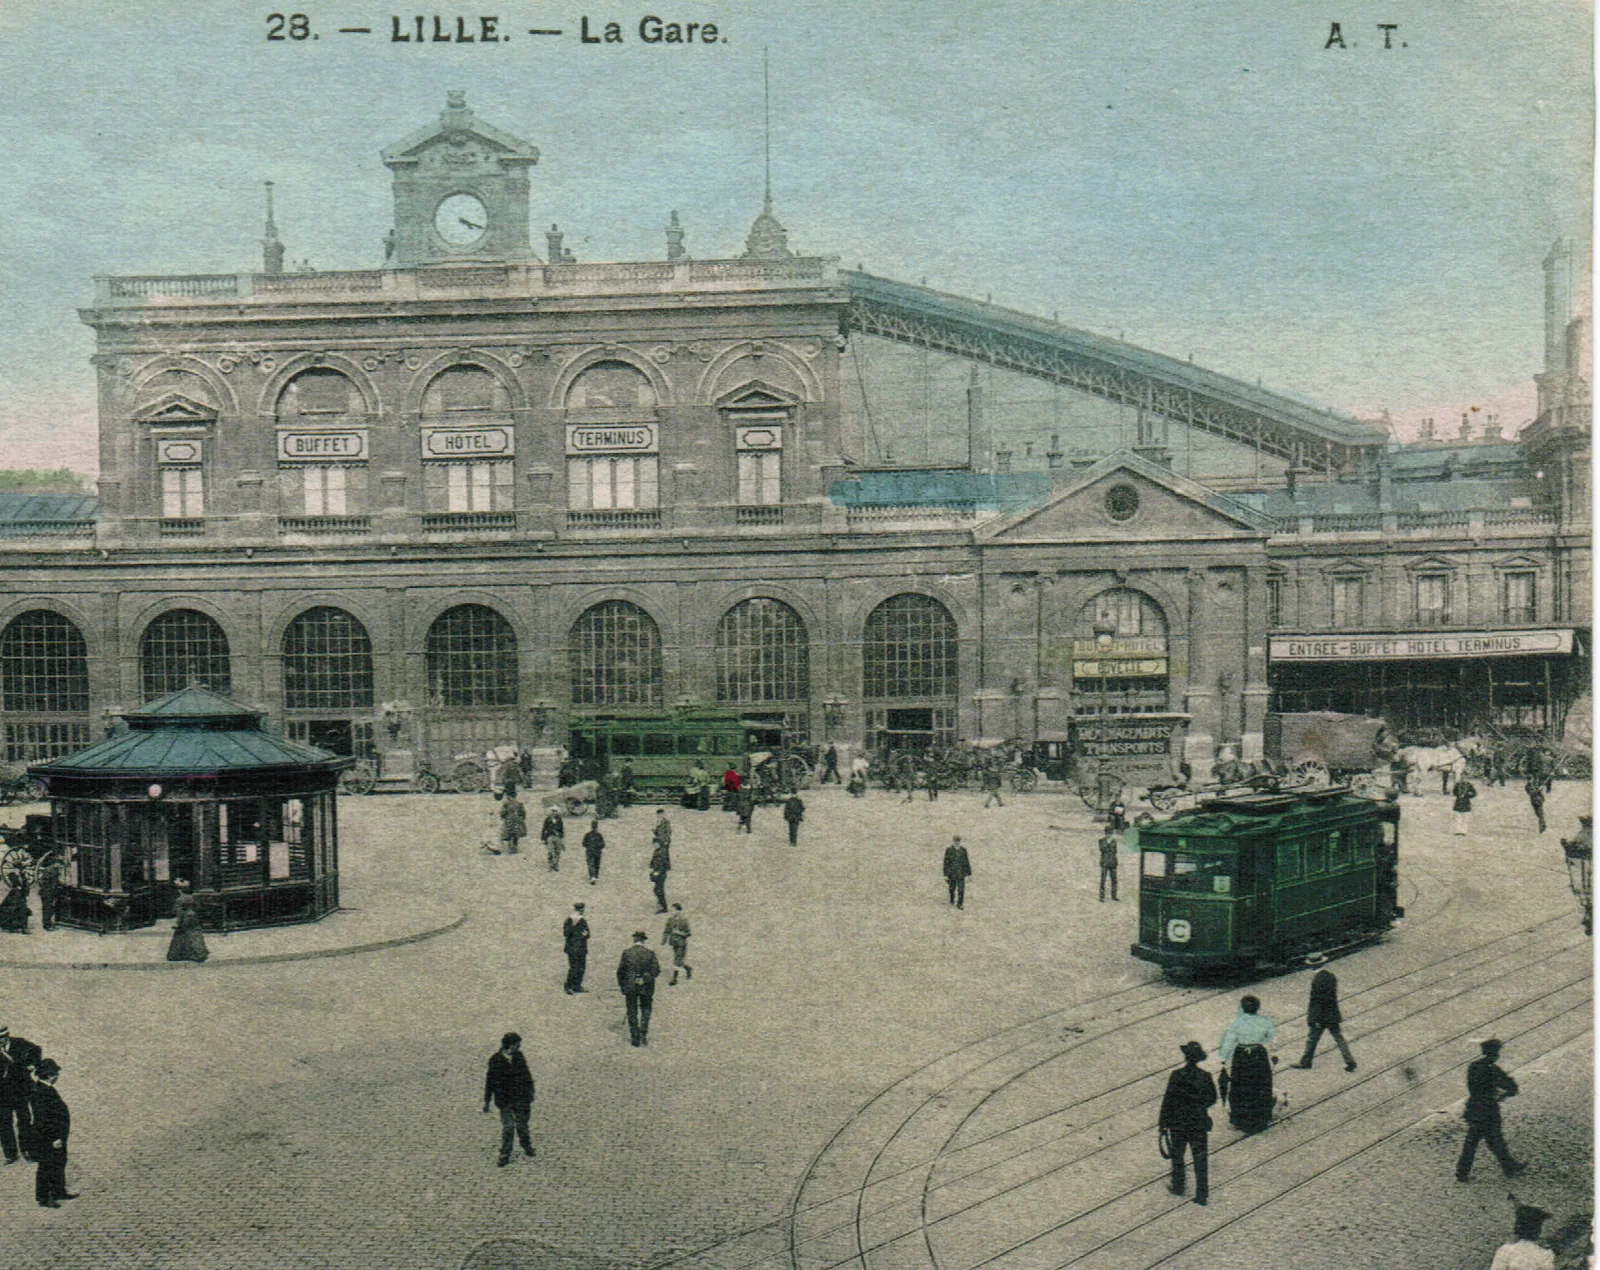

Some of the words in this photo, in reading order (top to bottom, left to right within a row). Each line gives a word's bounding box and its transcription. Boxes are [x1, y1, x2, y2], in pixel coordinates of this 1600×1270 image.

[296, 437, 349, 453] BUFFET
[445, 434, 492, 450] HOTEL
[578, 430, 644, 447] TERMINUS
[1408, 640, 1449, 653] HOTEL
[1457, 637, 1521, 652] TERMINUS
[1173, 924, 1187, 939] C
